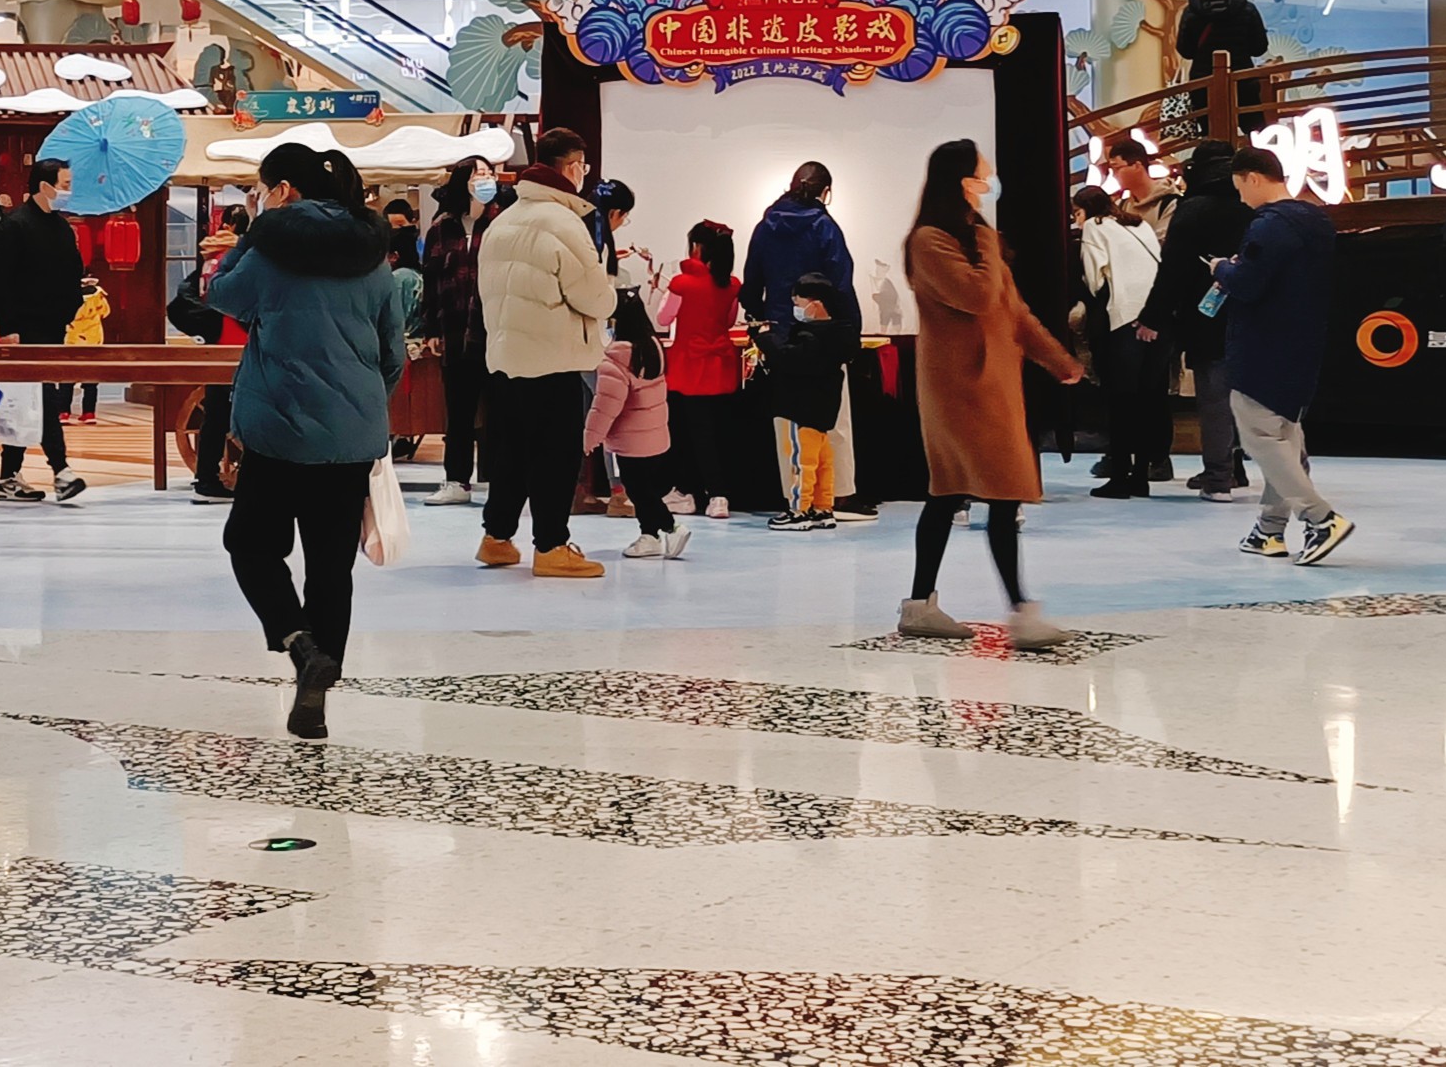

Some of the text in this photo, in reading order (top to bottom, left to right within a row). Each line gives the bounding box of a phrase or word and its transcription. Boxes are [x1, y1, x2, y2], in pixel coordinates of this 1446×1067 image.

[658, 13, 896, 45] 中国非遗皮影戏
[660, 45, 895, 56] Chinese Intangible Cultural Heritage Shadow Play
[731, 65, 757, 80] 2022
